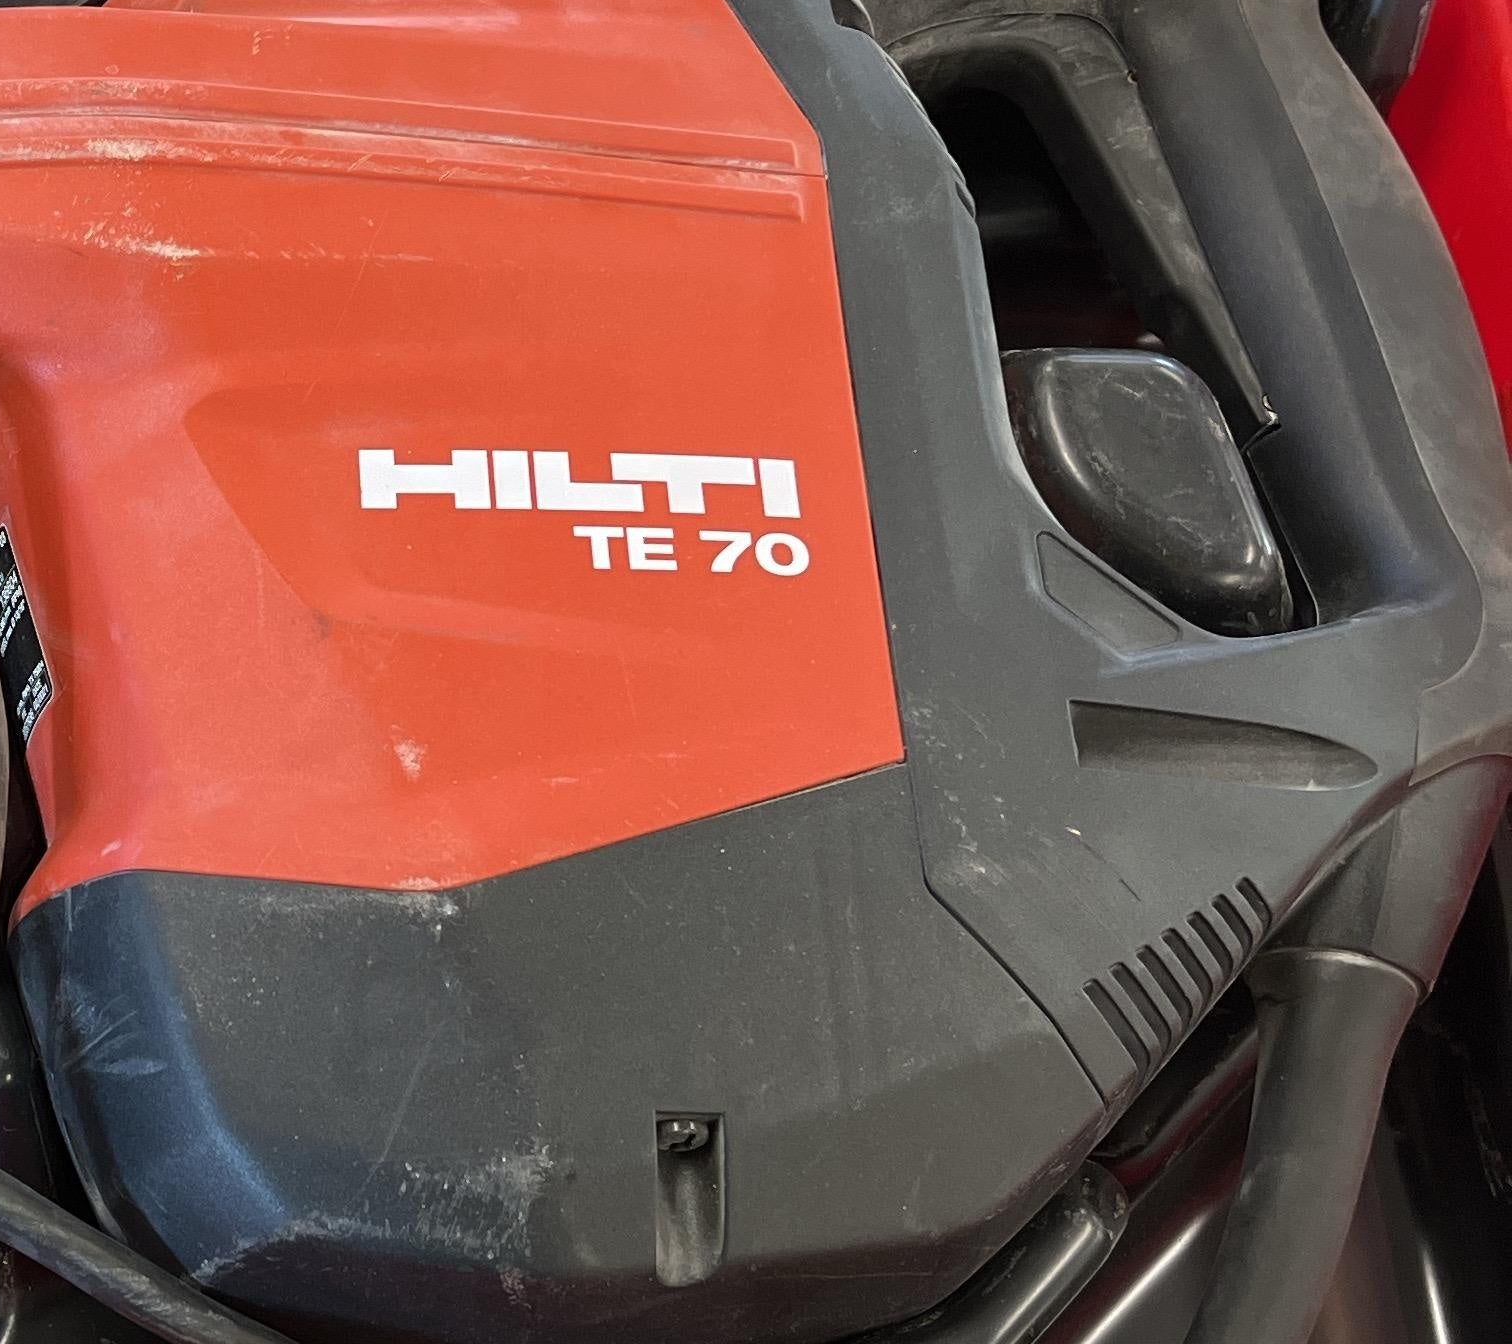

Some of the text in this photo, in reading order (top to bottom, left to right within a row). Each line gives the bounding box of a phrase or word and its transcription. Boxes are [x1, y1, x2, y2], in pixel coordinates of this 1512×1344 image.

[357, 448, 802, 519] HILTI
[573, 525, 810, 577] TE 70
